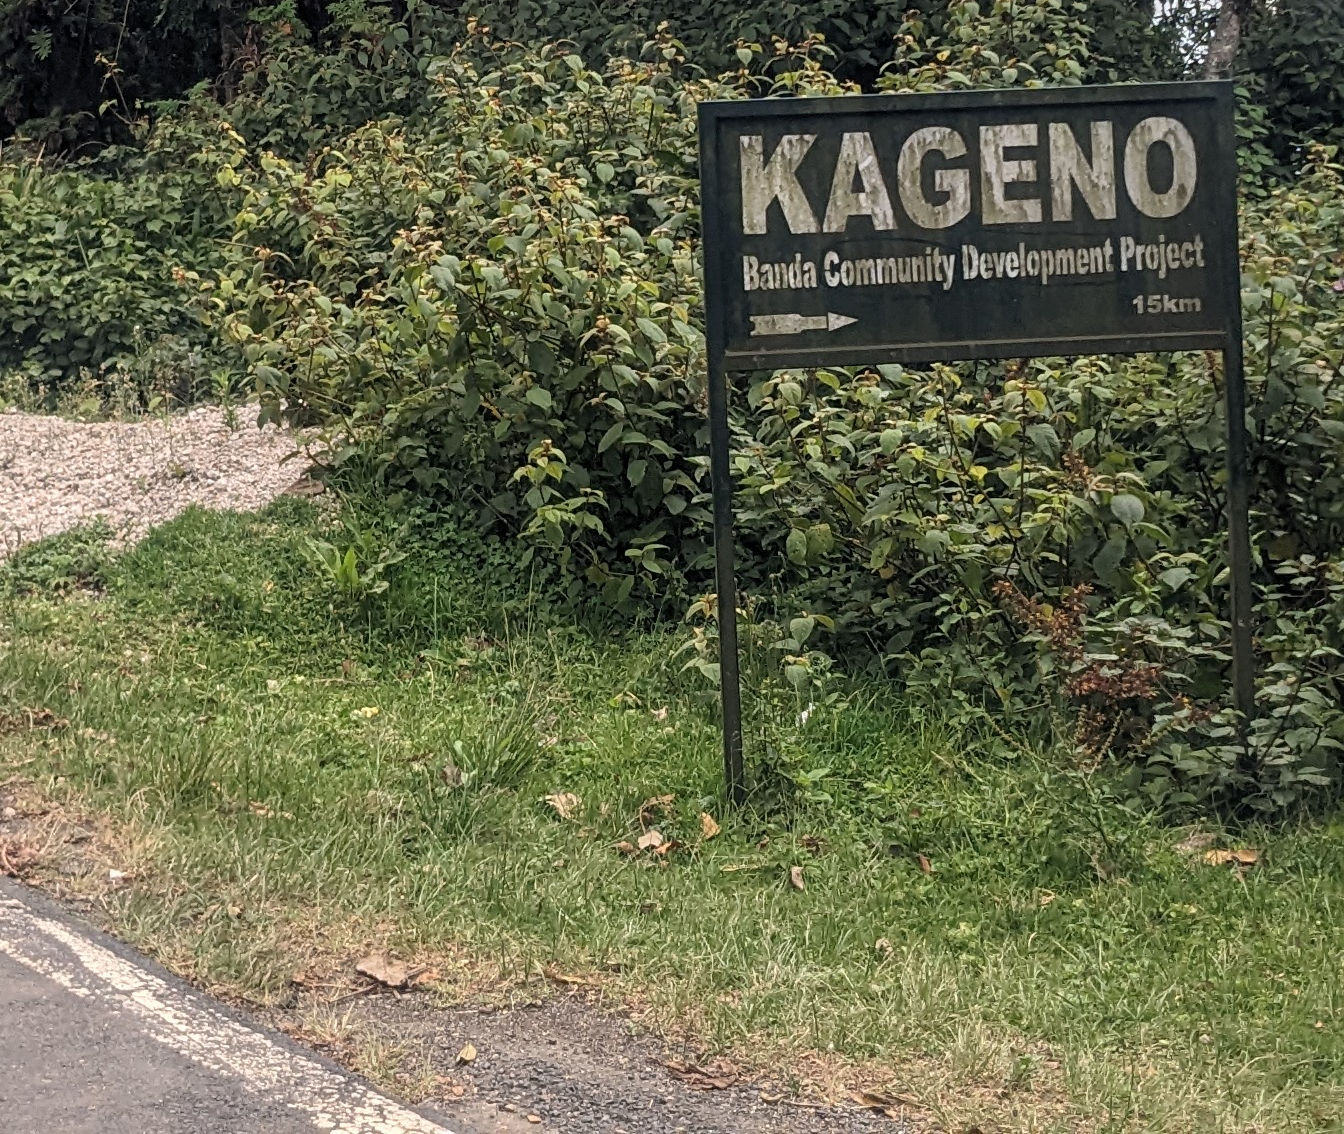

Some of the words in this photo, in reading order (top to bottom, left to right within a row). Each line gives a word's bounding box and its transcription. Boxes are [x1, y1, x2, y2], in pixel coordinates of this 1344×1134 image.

[739, 116, 1198, 235] KAGENO
[743, 253, 818, 291] Banda
[824, 246, 956, 291] Community
[961, 238, 1114, 285] Development
[1120, 233, 1205, 279] Project
[1132, 294, 1202, 314] 15km
